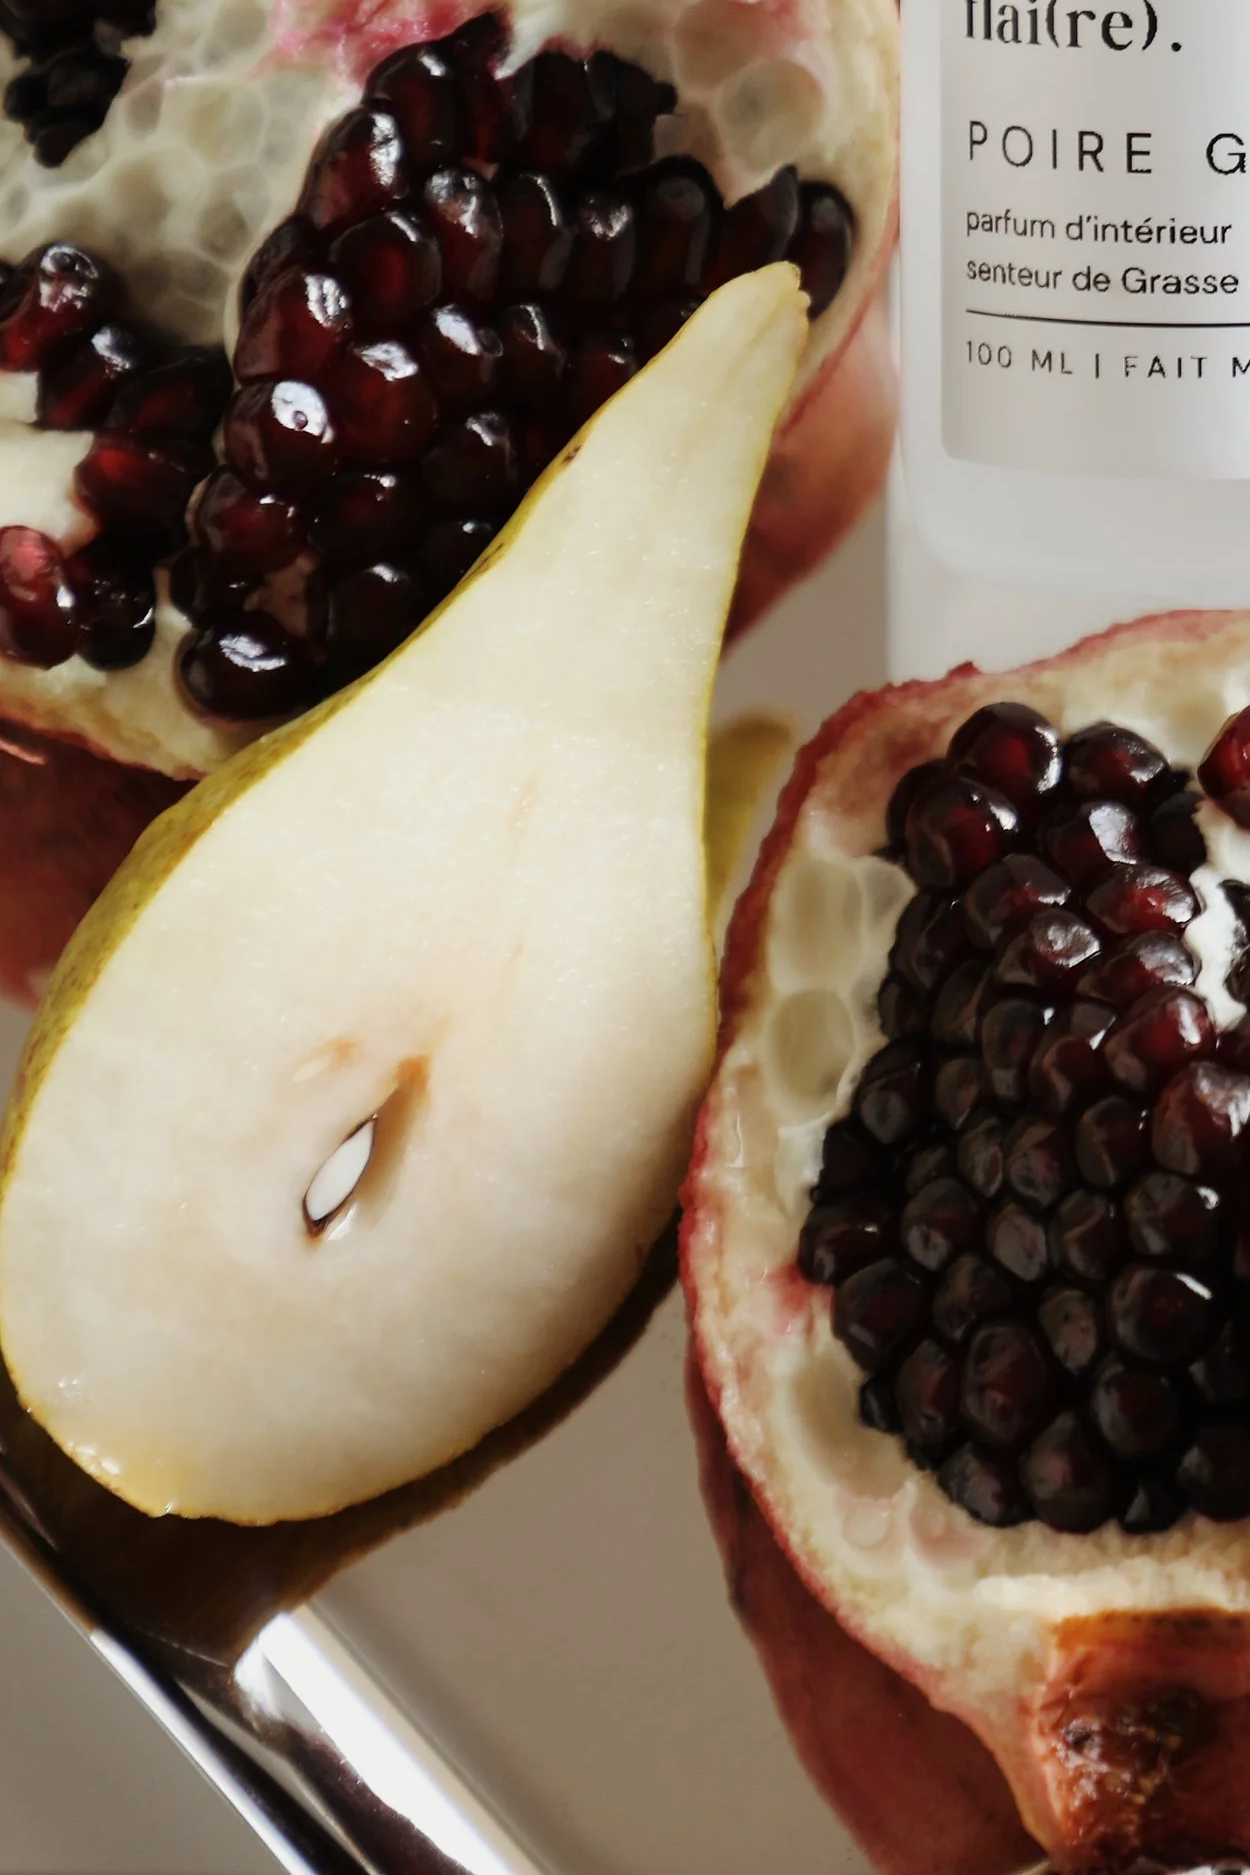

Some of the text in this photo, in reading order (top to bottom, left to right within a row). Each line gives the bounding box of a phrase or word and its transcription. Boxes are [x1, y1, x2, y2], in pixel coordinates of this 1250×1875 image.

[967, 119, 1155, 176] POIRE
[965, 207, 1057, 240] parfum
[965, 258, 1064, 291] senteur
[1071, 264, 1113, 294] de
[1119, 265, 1241, 296] Grasse
[965, 338, 1014, 369] 100
[1030, 348, 1075, 376] ML
[1122, 353, 1209, 380] FAIT
